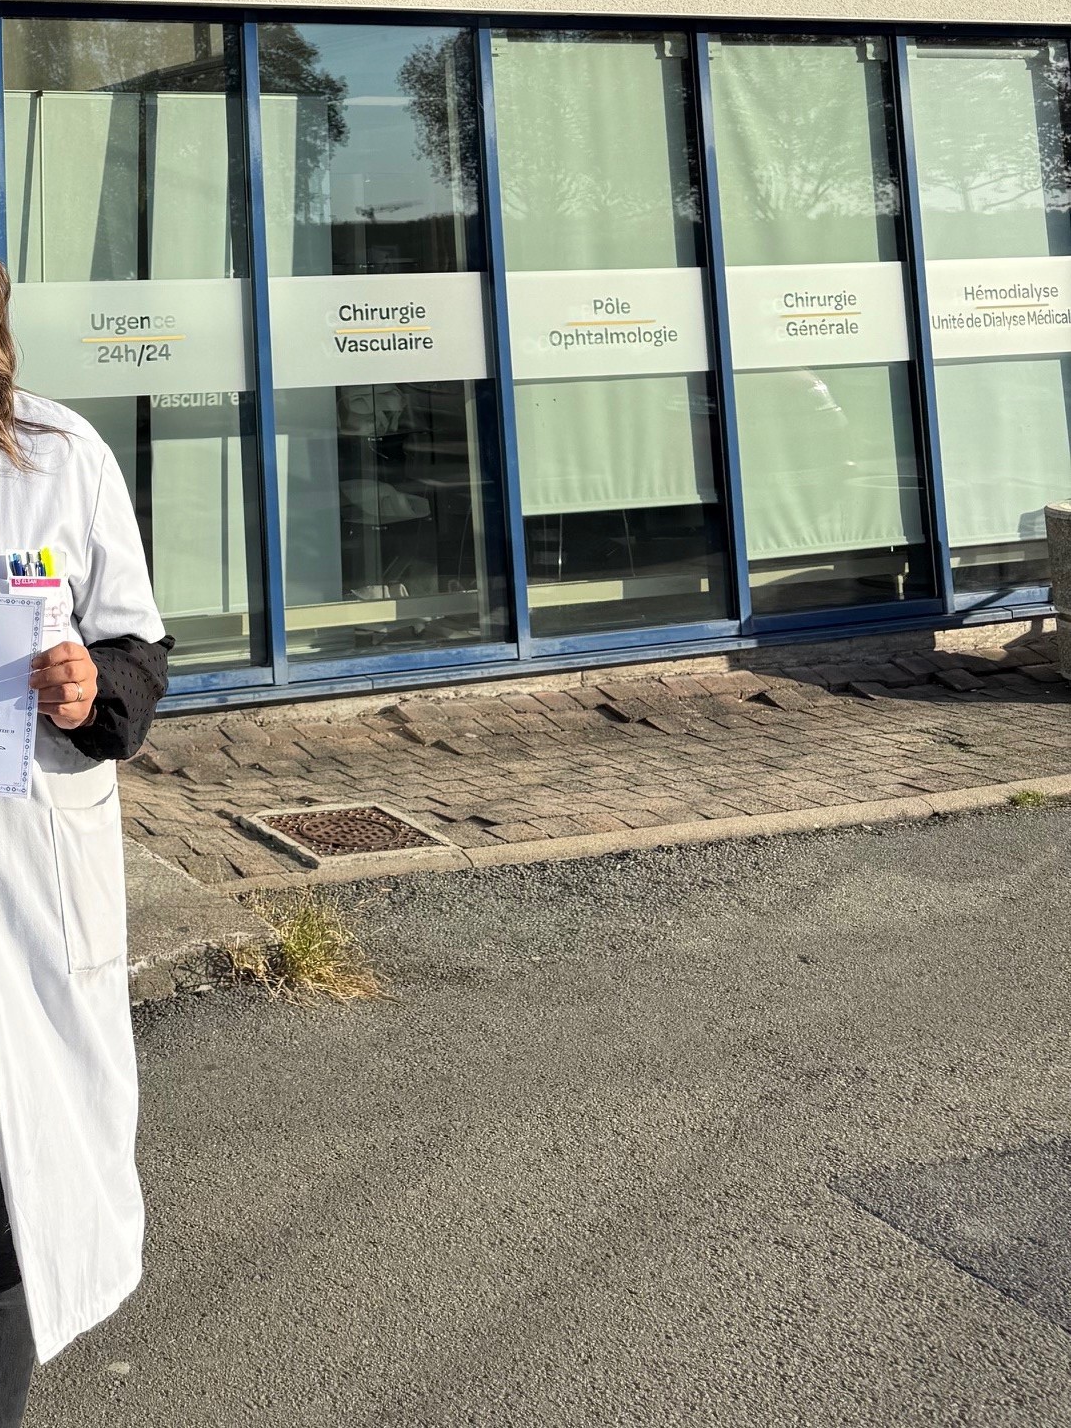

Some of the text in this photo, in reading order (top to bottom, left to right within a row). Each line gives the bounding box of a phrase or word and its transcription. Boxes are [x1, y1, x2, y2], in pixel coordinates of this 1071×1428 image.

[782, 290, 858, 310] Chirurgie
[964, 283, 1059, 302] Hémodialyse
[338, 301, 427, 325] Chirurgie
[592, 297, 631, 316] Pôle
[90, 312, 176, 336] Urgence
[785, 317, 859, 338] Générale
[931, 313, 965, 330] Unité
[966, 313, 982, 328] de
[983, 312, 1026, 330] Dialyse
[334, 333, 434, 355] Vasculaire
[548, 326, 679, 350] Ophtalmologie
[97, 343, 172, 368] 24h/24
